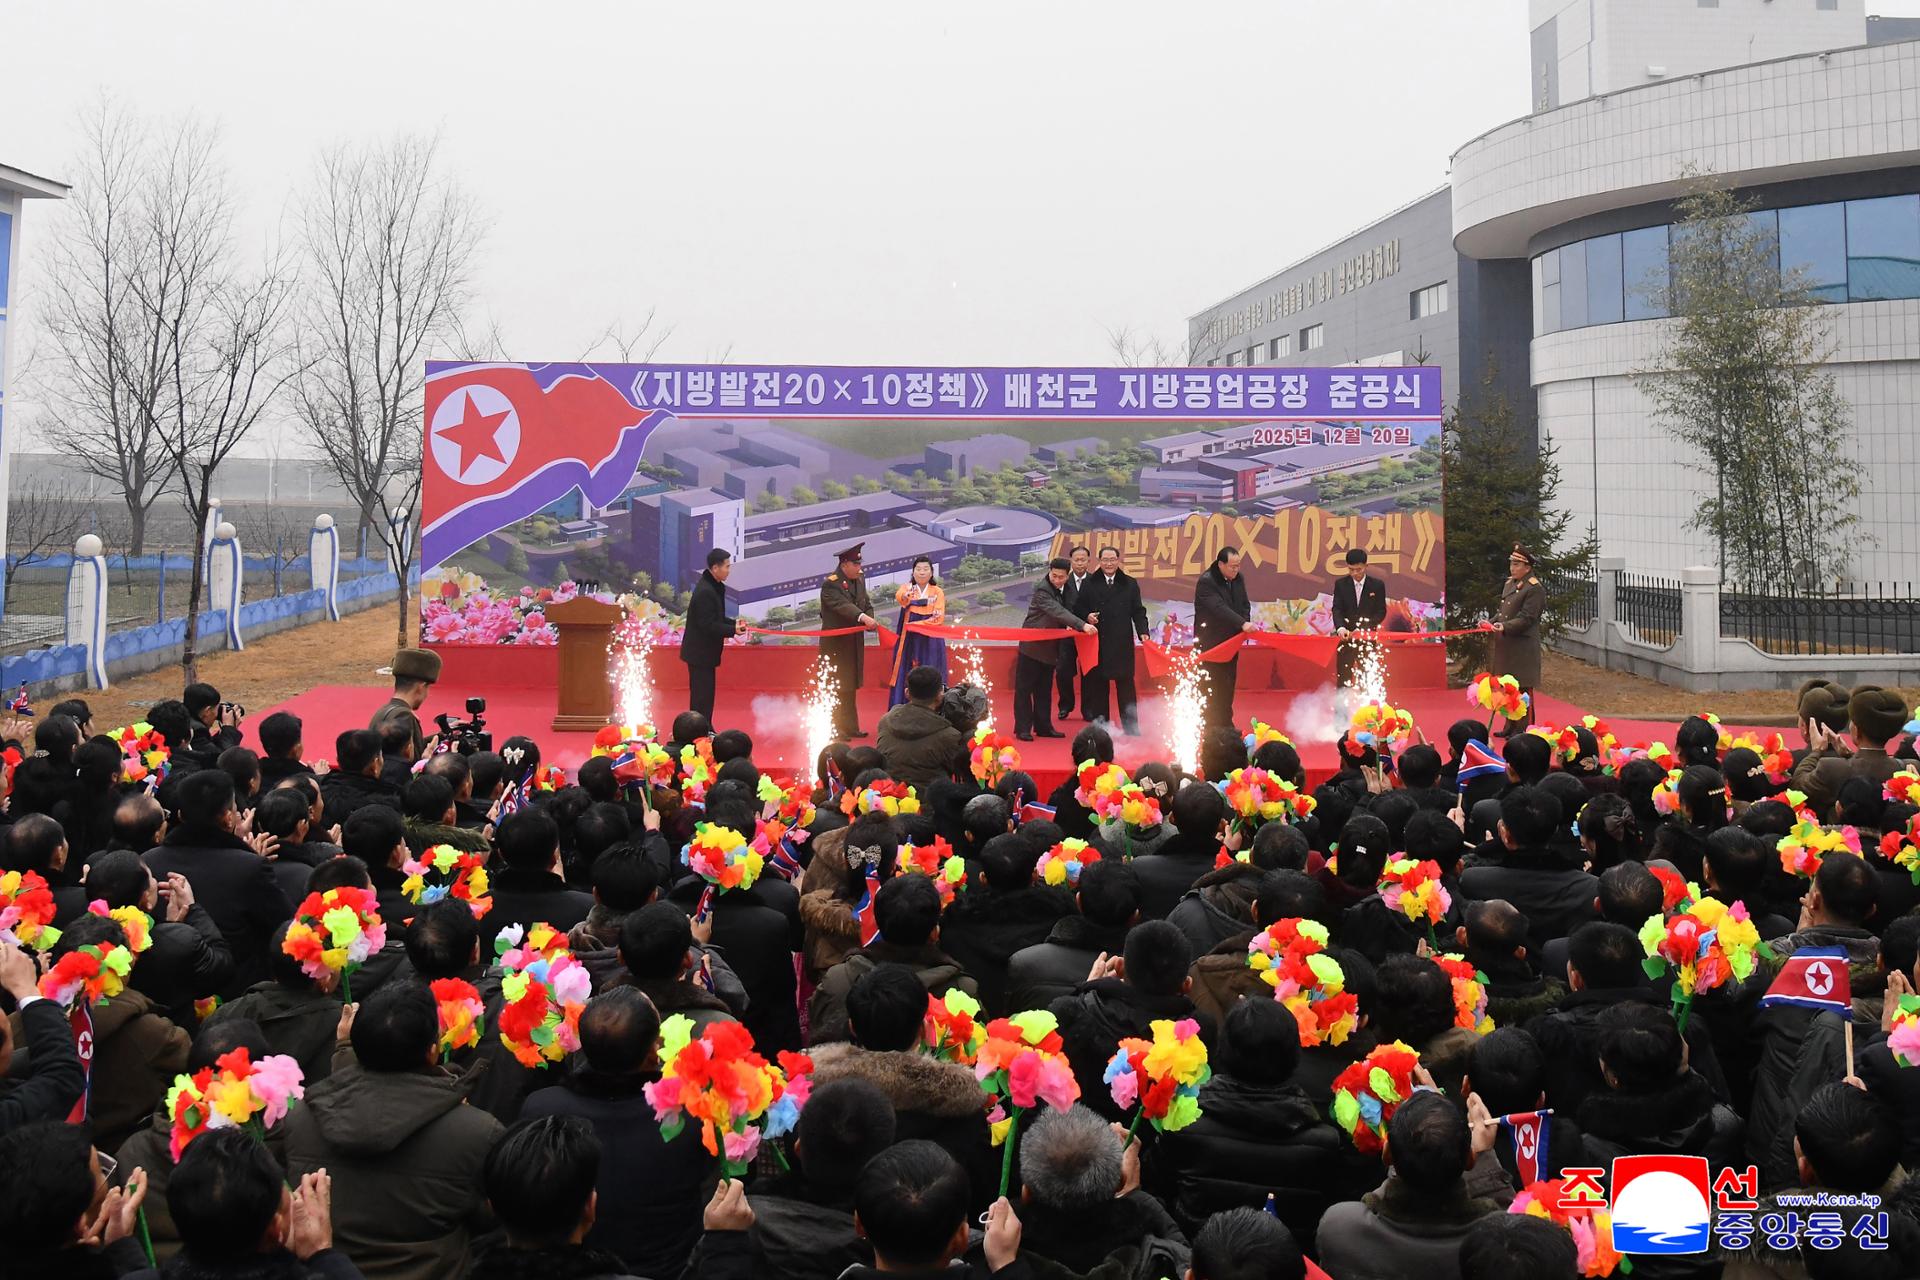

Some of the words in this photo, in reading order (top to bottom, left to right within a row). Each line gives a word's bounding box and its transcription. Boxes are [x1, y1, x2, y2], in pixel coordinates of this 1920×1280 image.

[1319, 268, 1334, 303] 많이
[1004, 374, 1098, 409] 배천군
[1119, 374, 1309, 409] 지방공업공장
[1328, 374, 1421, 409] 준공식
[1254, 427, 1312, 445] 2025년
[1324, 427, 1362, 445] 12월
[1372, 427, 1411, 445] 20일
